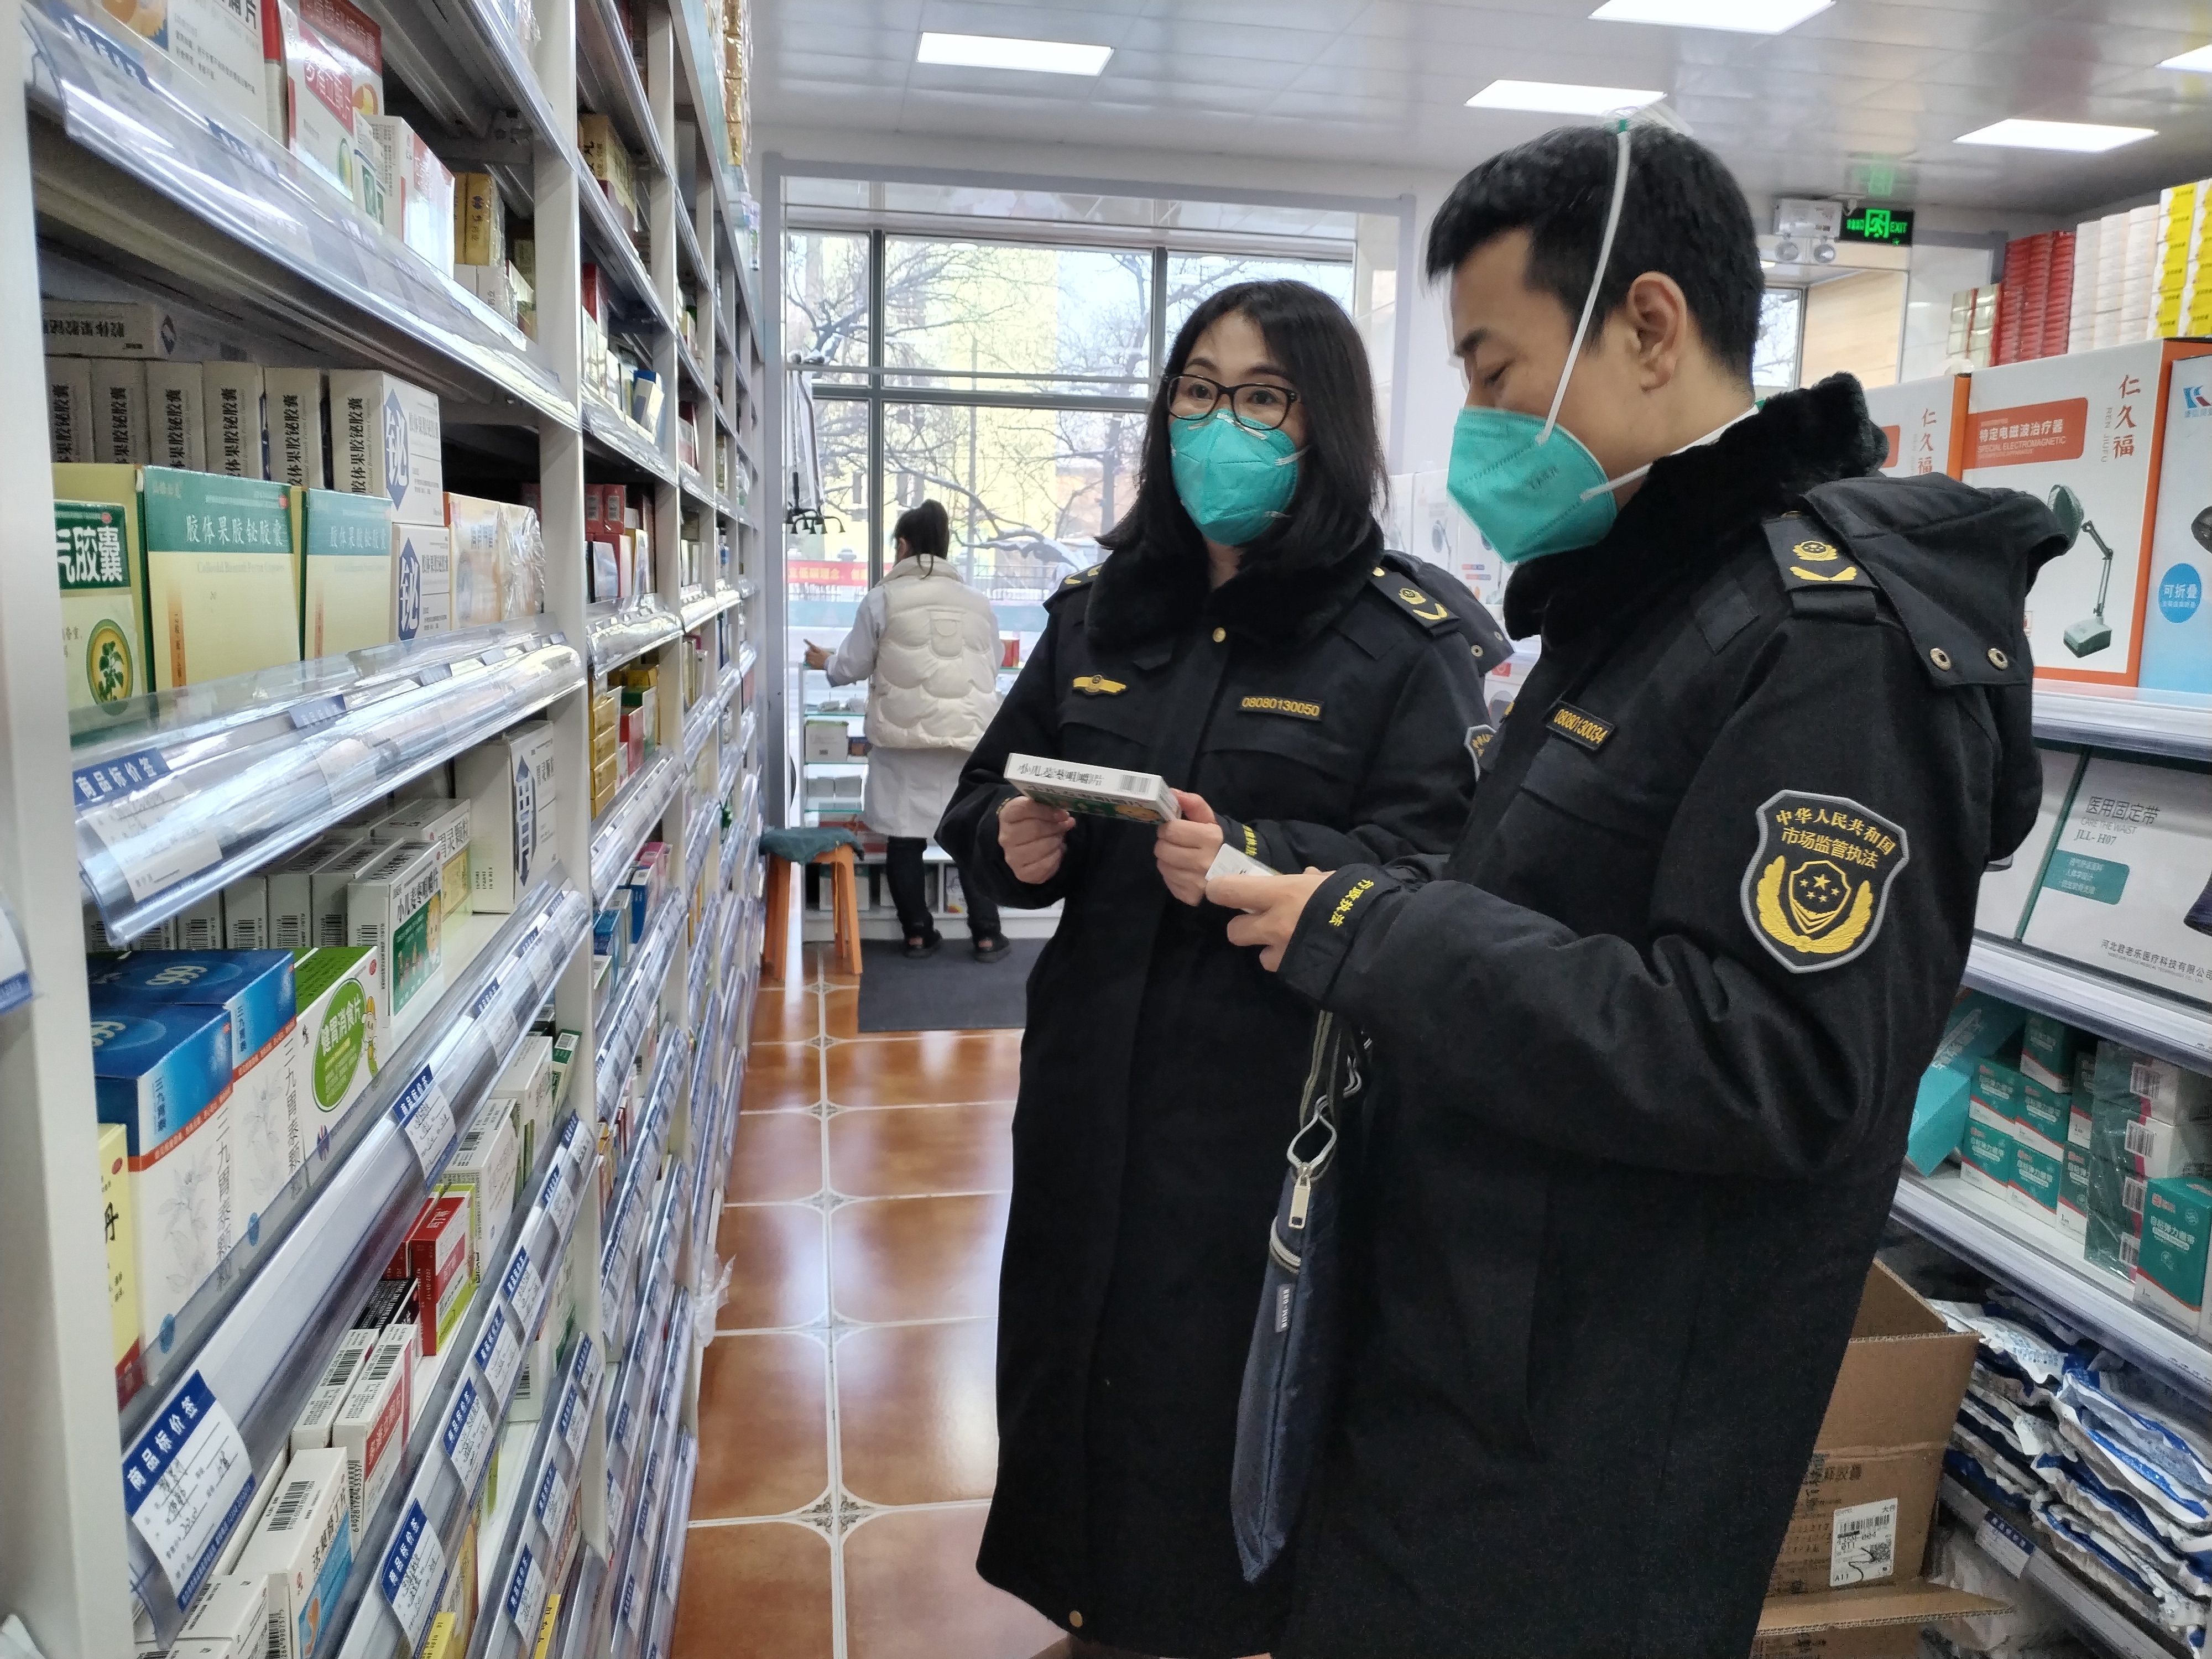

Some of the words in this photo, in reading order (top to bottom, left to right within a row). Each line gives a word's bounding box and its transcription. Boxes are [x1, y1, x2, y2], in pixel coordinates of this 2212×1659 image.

[1890, 222, 1908, 233] EXIT
[1979, 419, 2064, 442] 特定电磁波治疗器
[2112, 374, 2141, 460] 仁久福
[2163, 583, 2198, 599] 可折叠
[1241, 697, 1320, 717] 08080130050
[75, 757, 158, 799] 商品标价签
[2085, 796, 2161, 826] 医用固定带
[1776, 808, 1896, 857] 中华人民共和国
[1781, 827, 1879, 869] 市场监管执法
[320, 993, 362, 1055] 健胃消食片
[447, 1390, 471, 1443] 商品标价签
[127, 1395, 199, 1492] 商品标价签
[389, 1516, 421, 1587] 商品标价签
